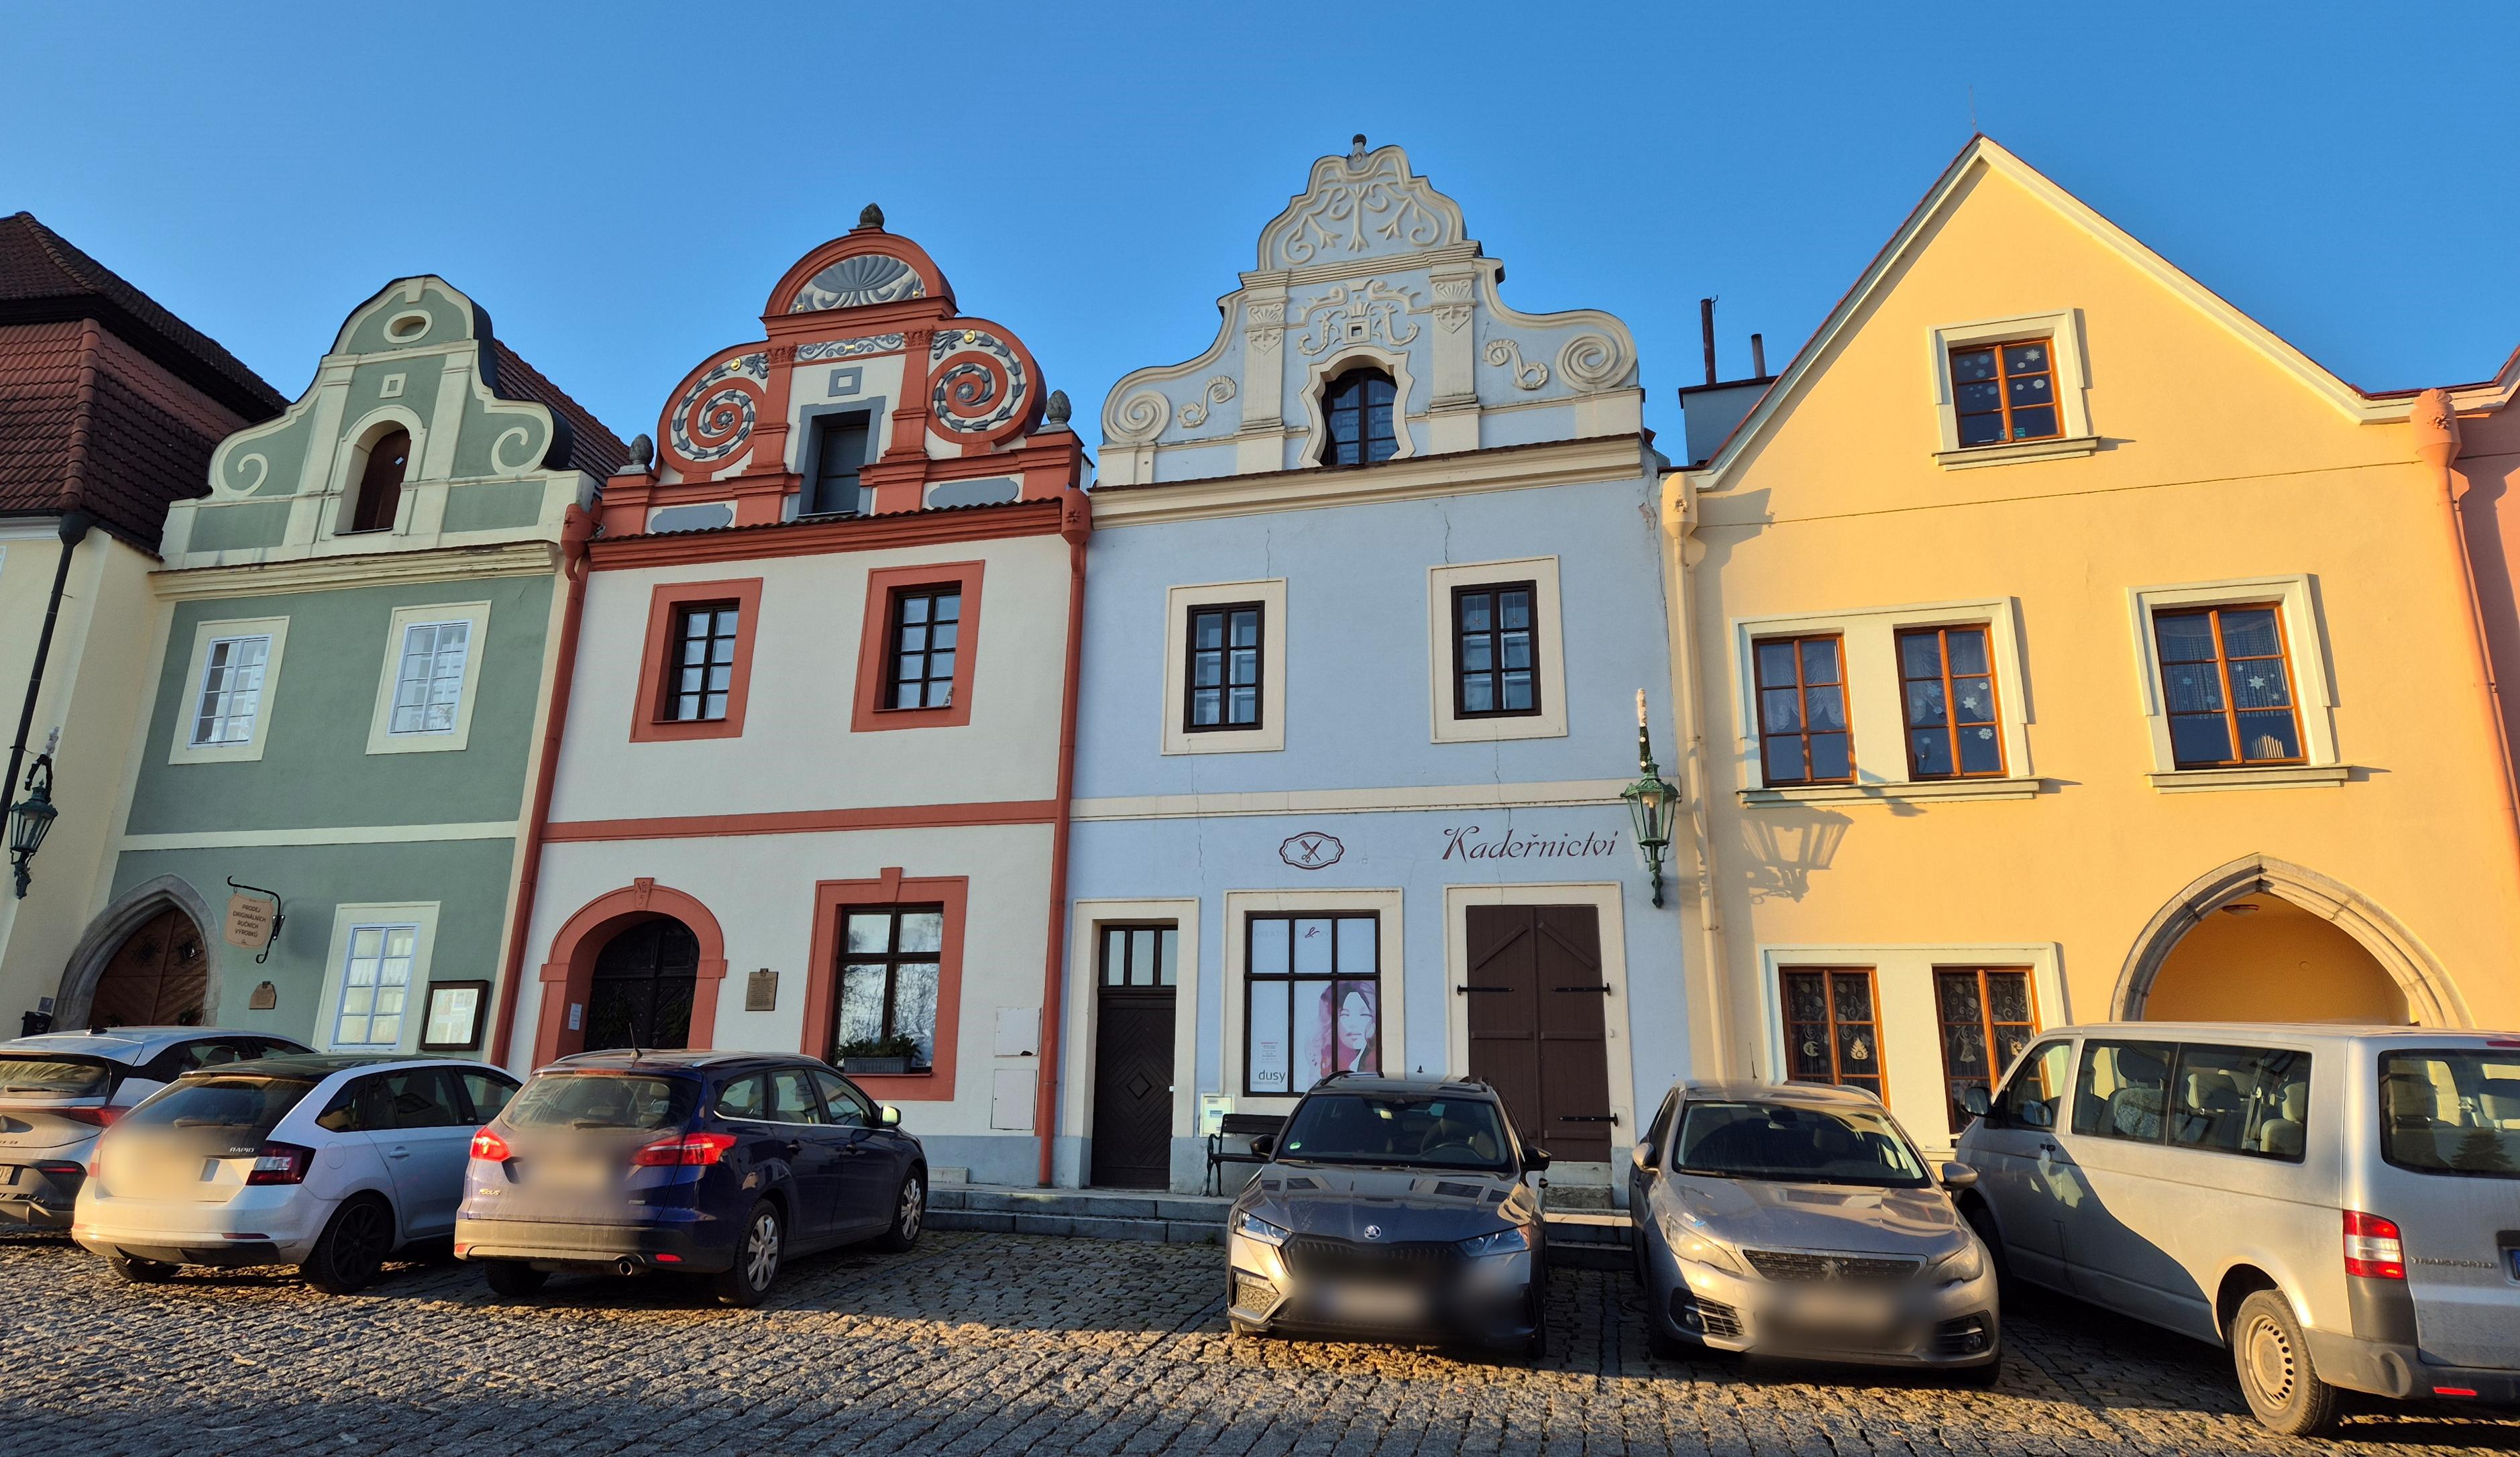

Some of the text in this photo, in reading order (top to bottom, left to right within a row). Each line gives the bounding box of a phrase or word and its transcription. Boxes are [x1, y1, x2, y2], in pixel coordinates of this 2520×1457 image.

[1442, 826, 1619, 864] Kadeřnictví
[242, 904, 260, 913] PRODEJ
[1258, 1069, 1286, 1083] dusy
[2411, 1256, 2498, 1269] TRANSPORTER
